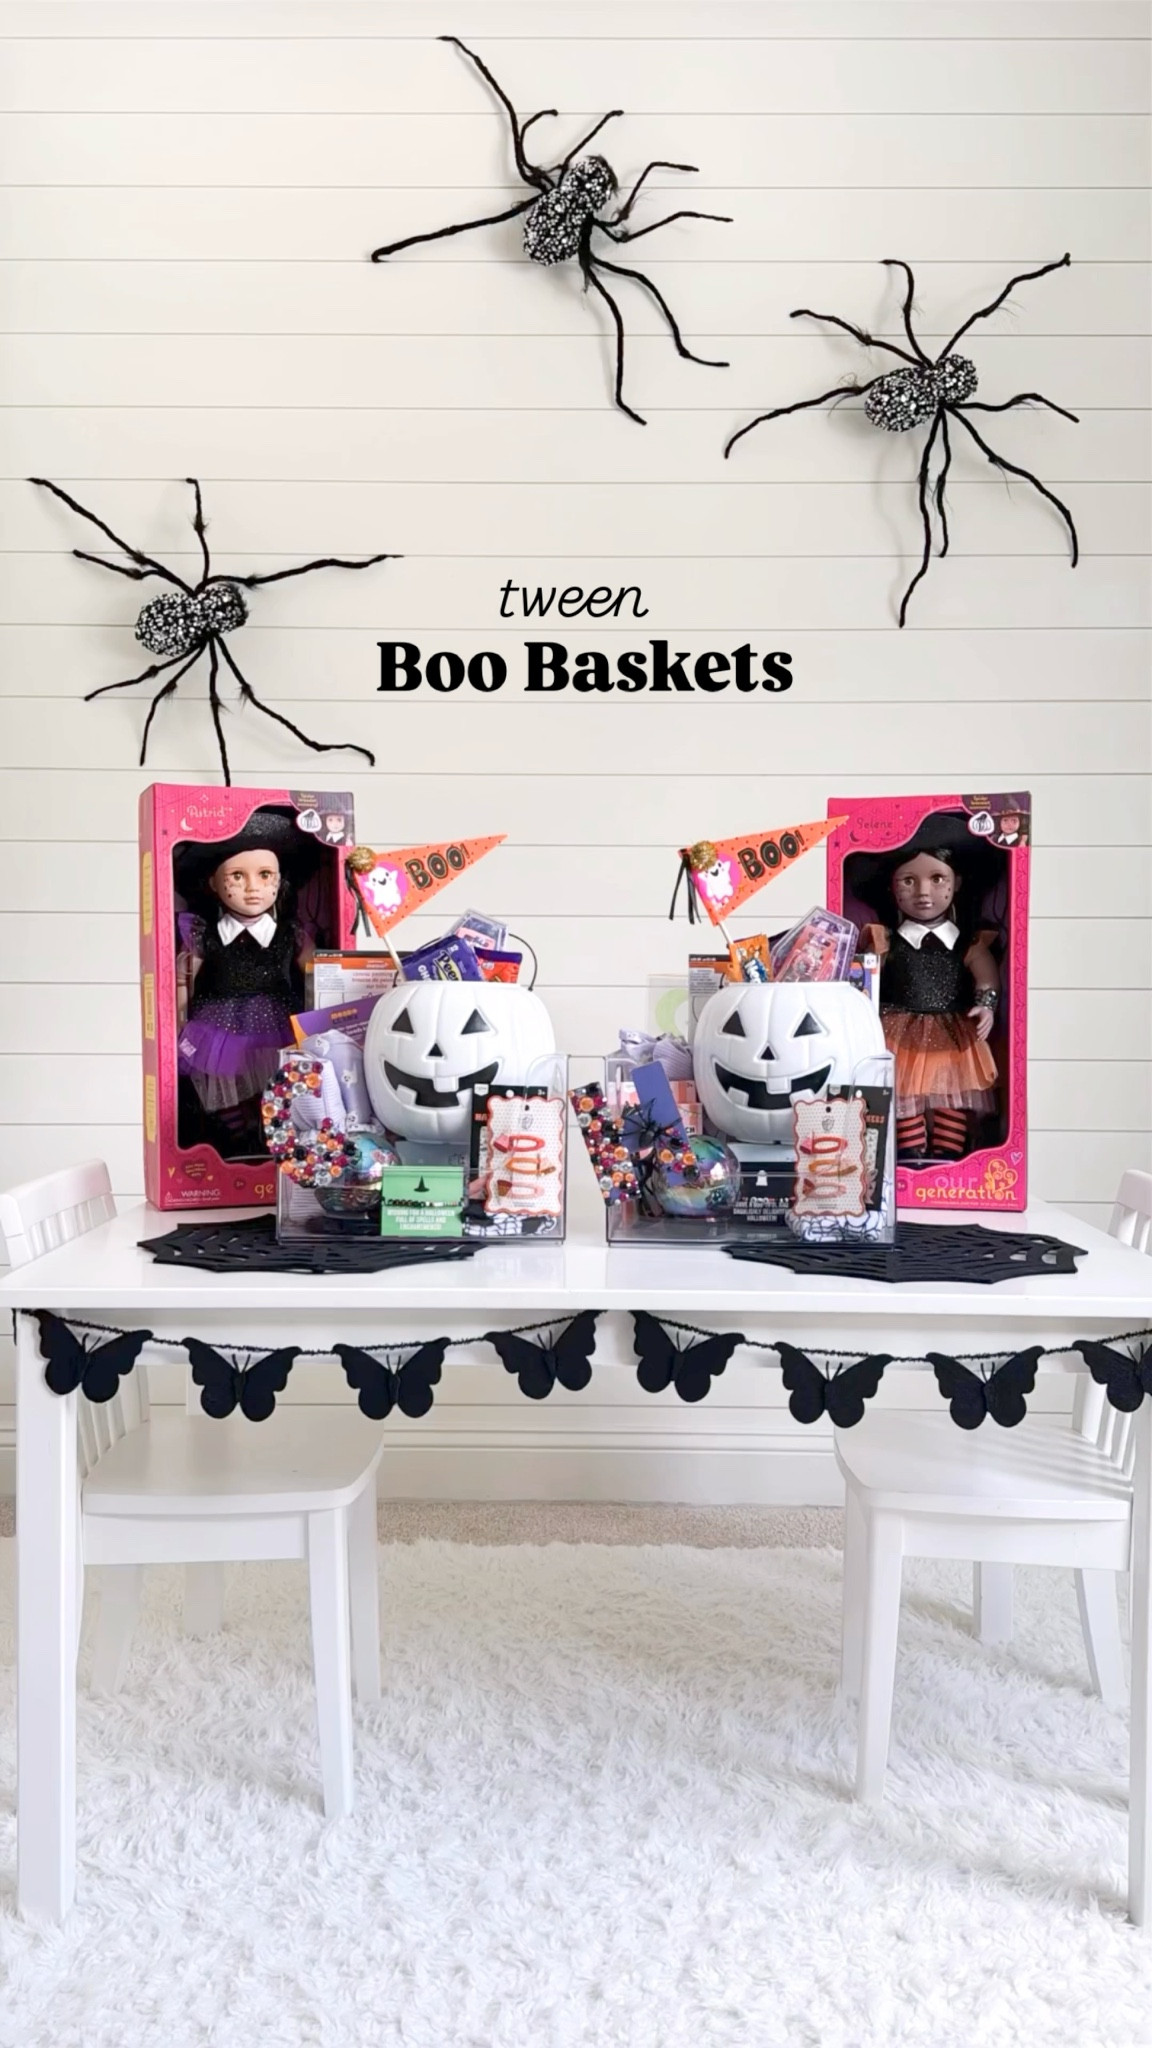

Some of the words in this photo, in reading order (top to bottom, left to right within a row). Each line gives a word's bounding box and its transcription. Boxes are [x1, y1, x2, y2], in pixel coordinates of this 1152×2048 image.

[405, 842, 473, 890] BOO!
[737, 829, 808, 881] BOO!
[915, 1184, 1017, 1203] generation
[935, 1176, 978, 1190] our
